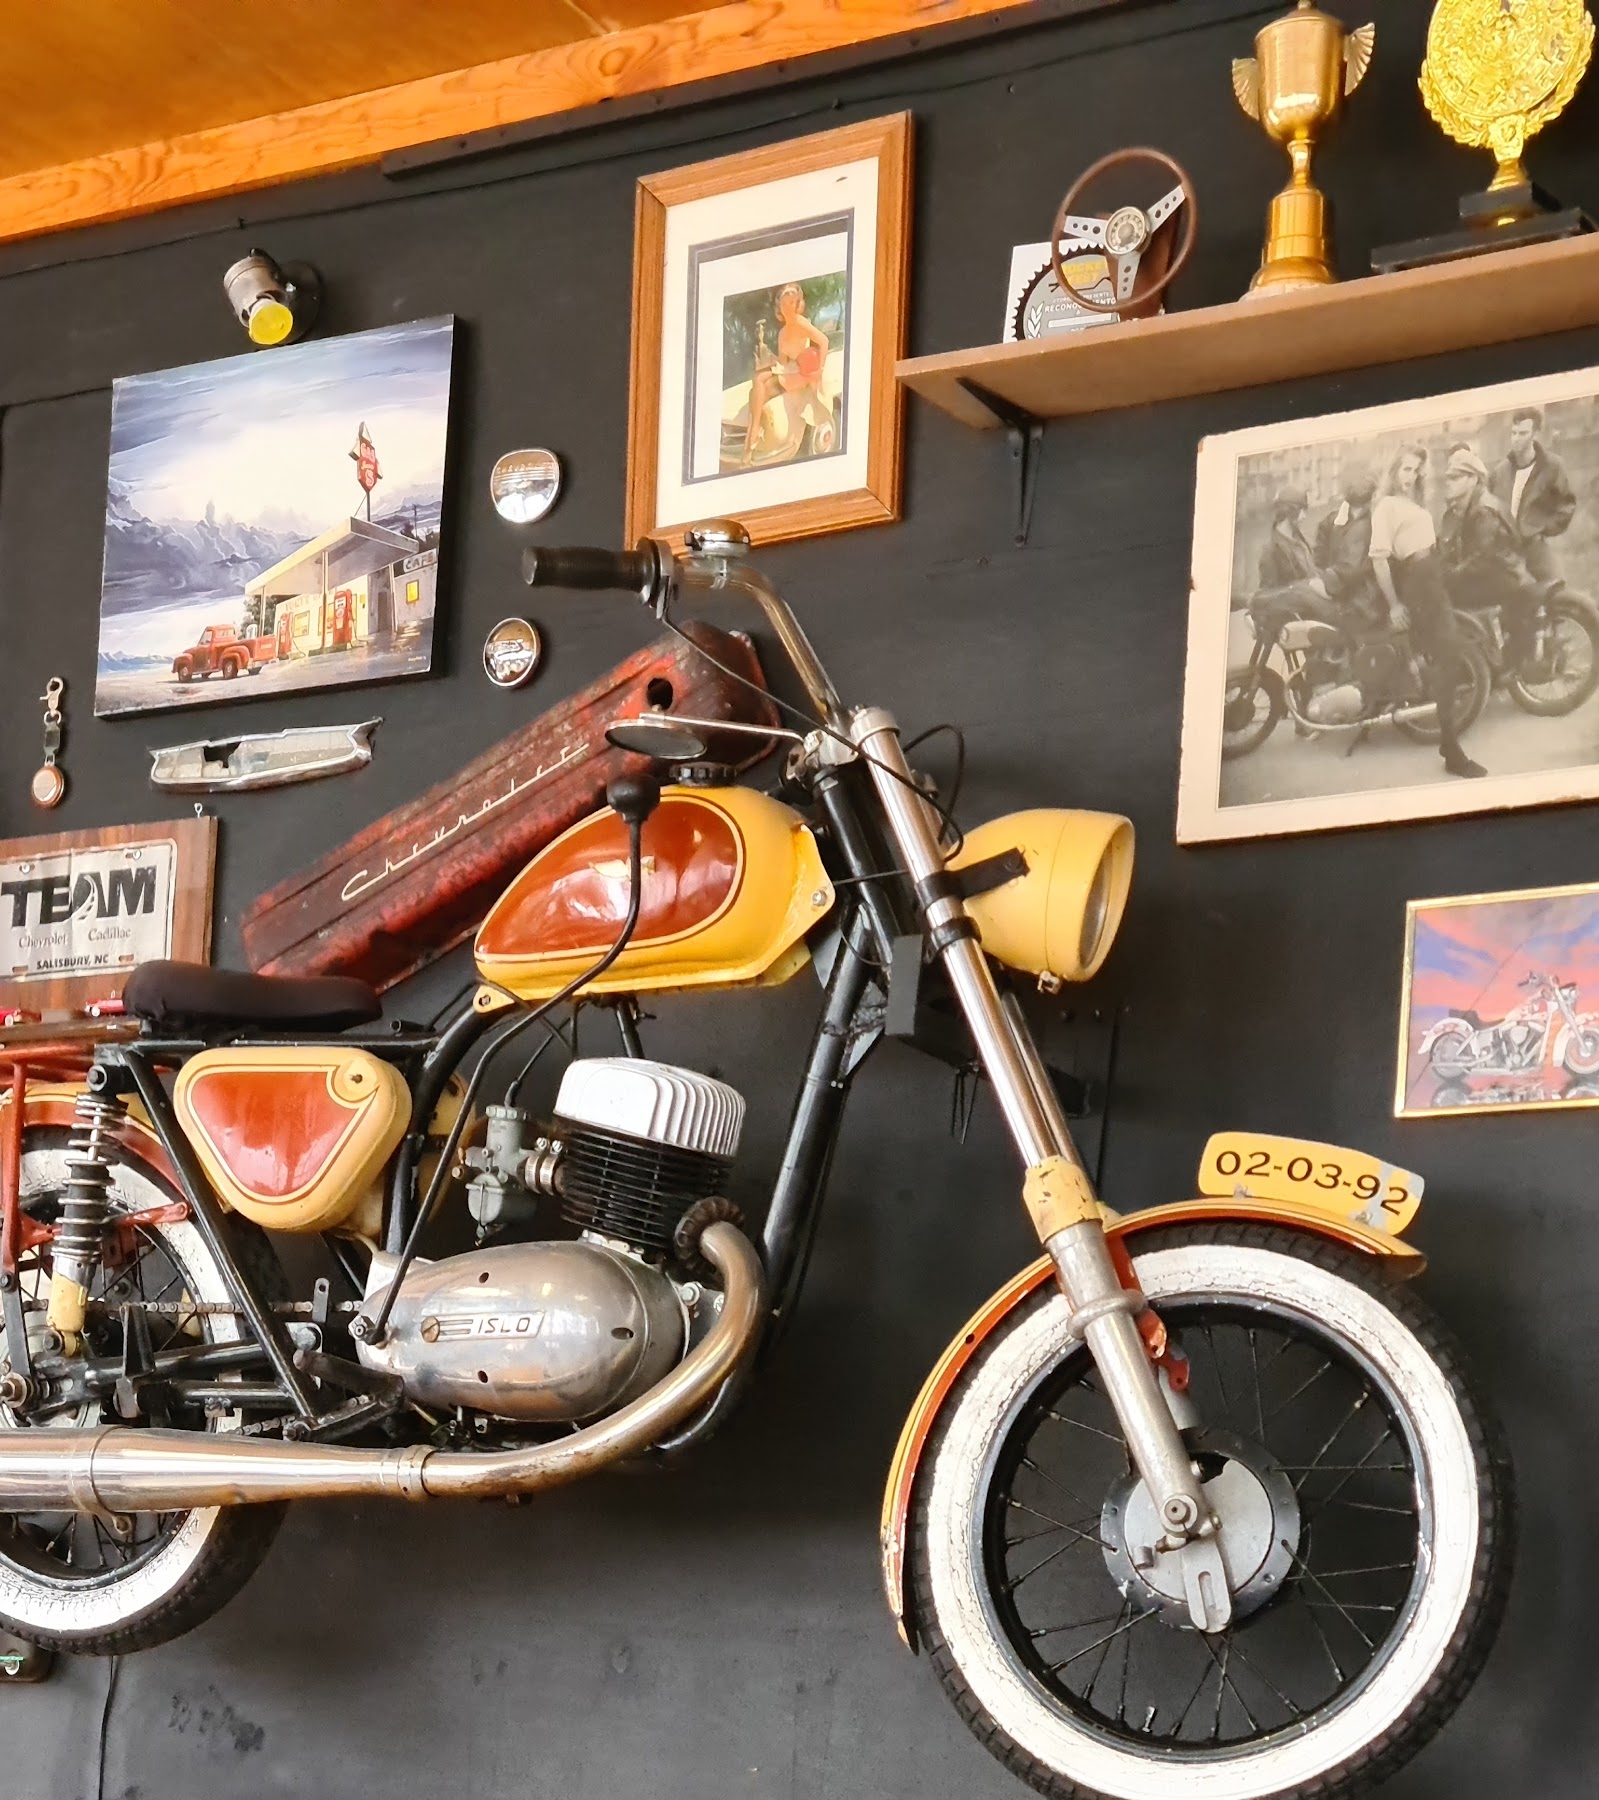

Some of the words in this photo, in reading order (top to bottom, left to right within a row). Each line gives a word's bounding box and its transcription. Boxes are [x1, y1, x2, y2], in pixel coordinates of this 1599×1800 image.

[1044, 297, 1117, 313] RECONOENTO
[405, 552, 437, 572] CAFE
[341, 742, 590, 902] Chevrolet
[0, 865, 158, 928] TEAM
[18, 932, 69, 949] Chevrolet
[88, 926, 132, 942] Cadillac
[94, 953, 109, 965] NC
[1215, 1150, 1409, 1216] 02-03-92
[477, 1316, 531, 1335] ISLO
